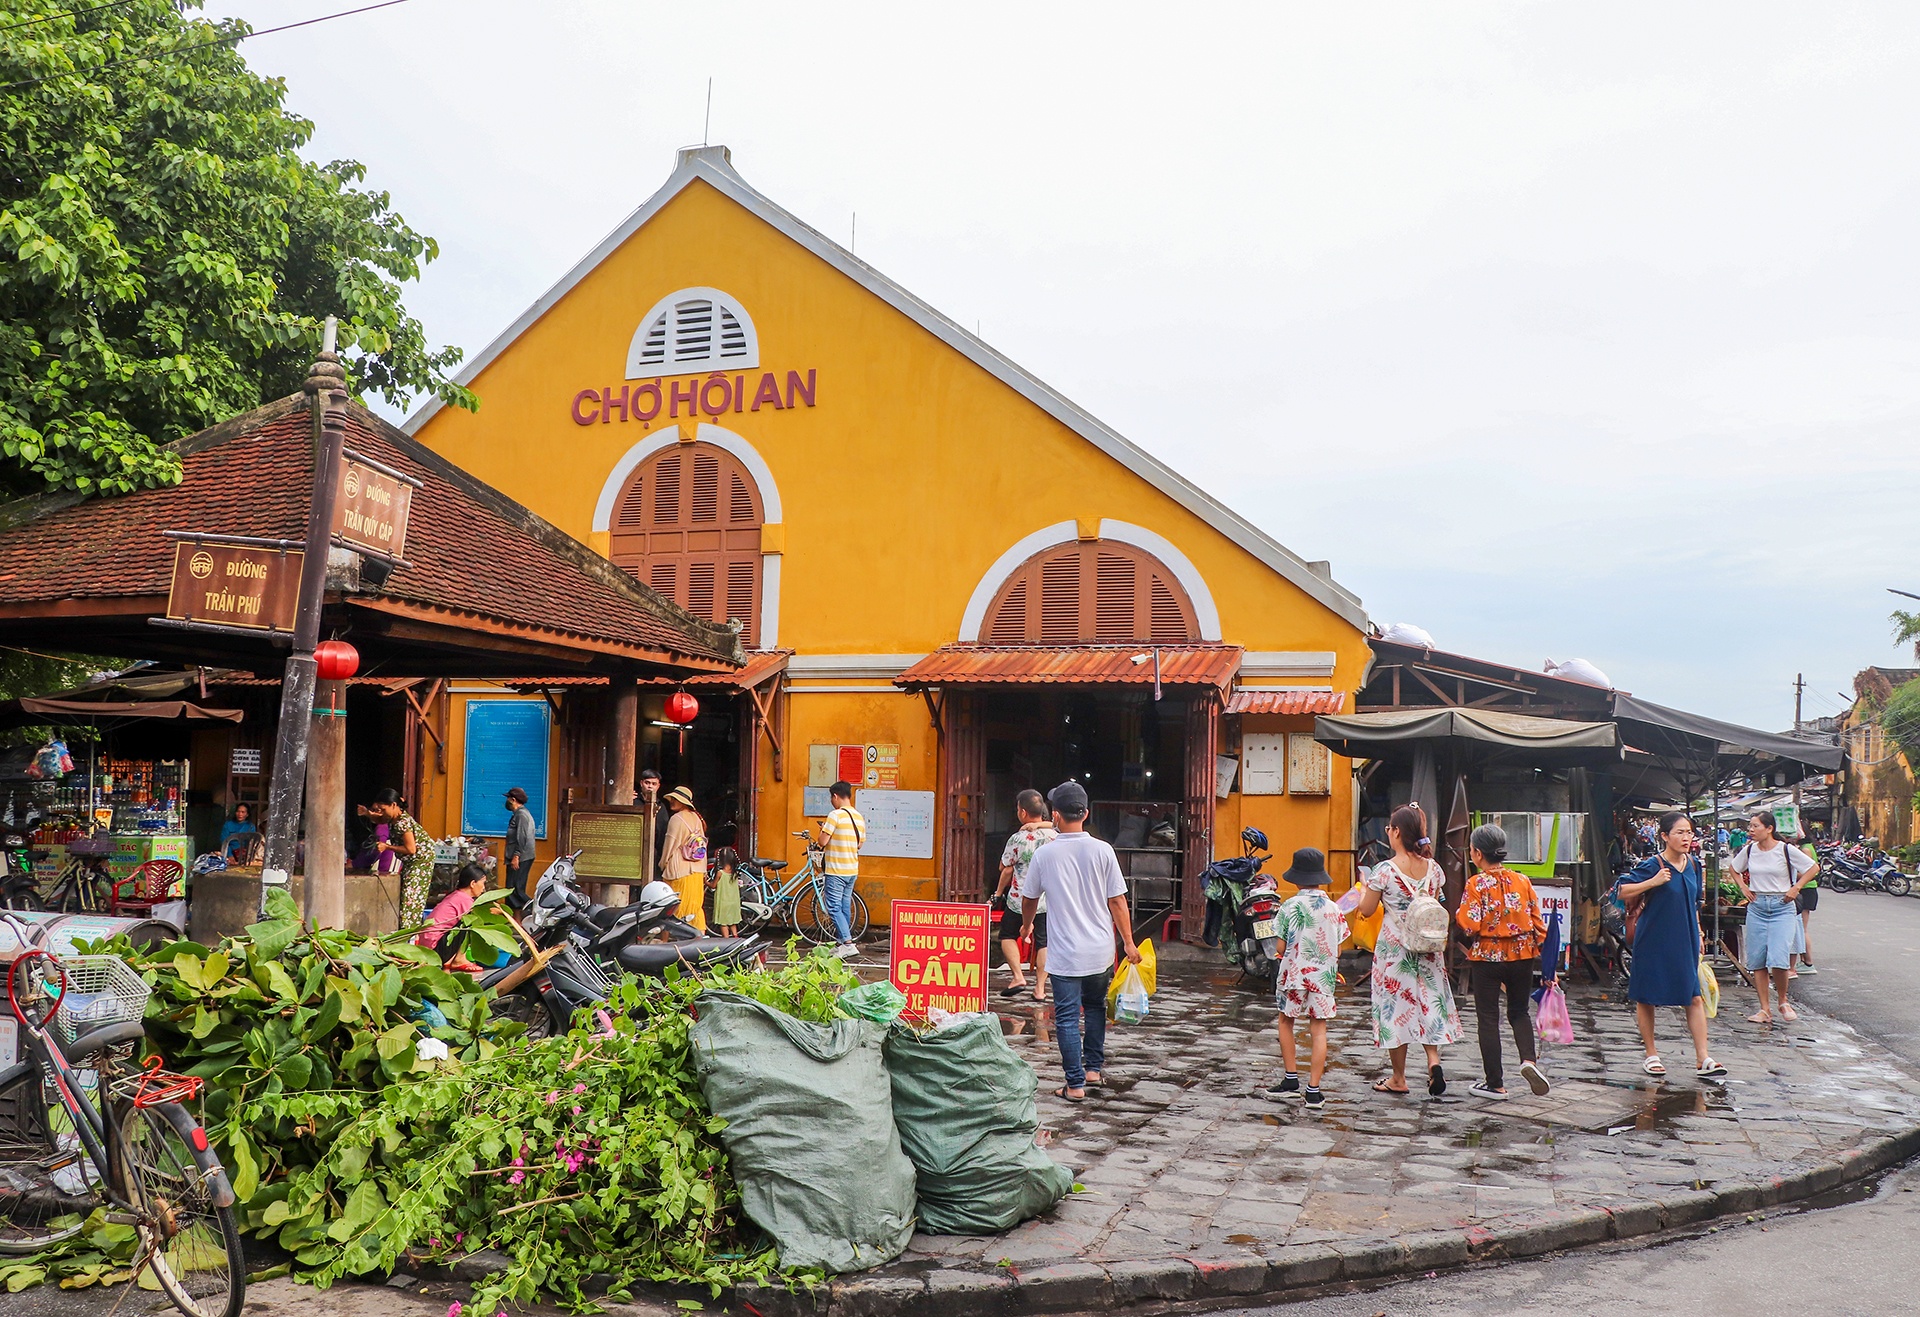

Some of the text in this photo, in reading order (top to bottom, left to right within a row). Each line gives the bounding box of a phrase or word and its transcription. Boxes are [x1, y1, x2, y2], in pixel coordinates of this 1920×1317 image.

[571, 368, 817, 429] CHỢ HỘI AN
[366, 484, 391, 506] ĐƯỜNG
[343, 506, 363, 532] TRẦN
[379, 520, 393, 542] CÁP
[226, 558, 268, 579] ĐƯỜNG
[205, 586, 261, 615] TRẦN PHÚ
[899, 910, 982, 928] BAN QUẢN LÝ CHỢ HỘI AN
[903, 934, 976, 954] KHU VỰC
[897, 952, 980, 988] CẤM
[911, 993, 926, 1013] XE,
[958, 993, 980, 1012] BÁN
